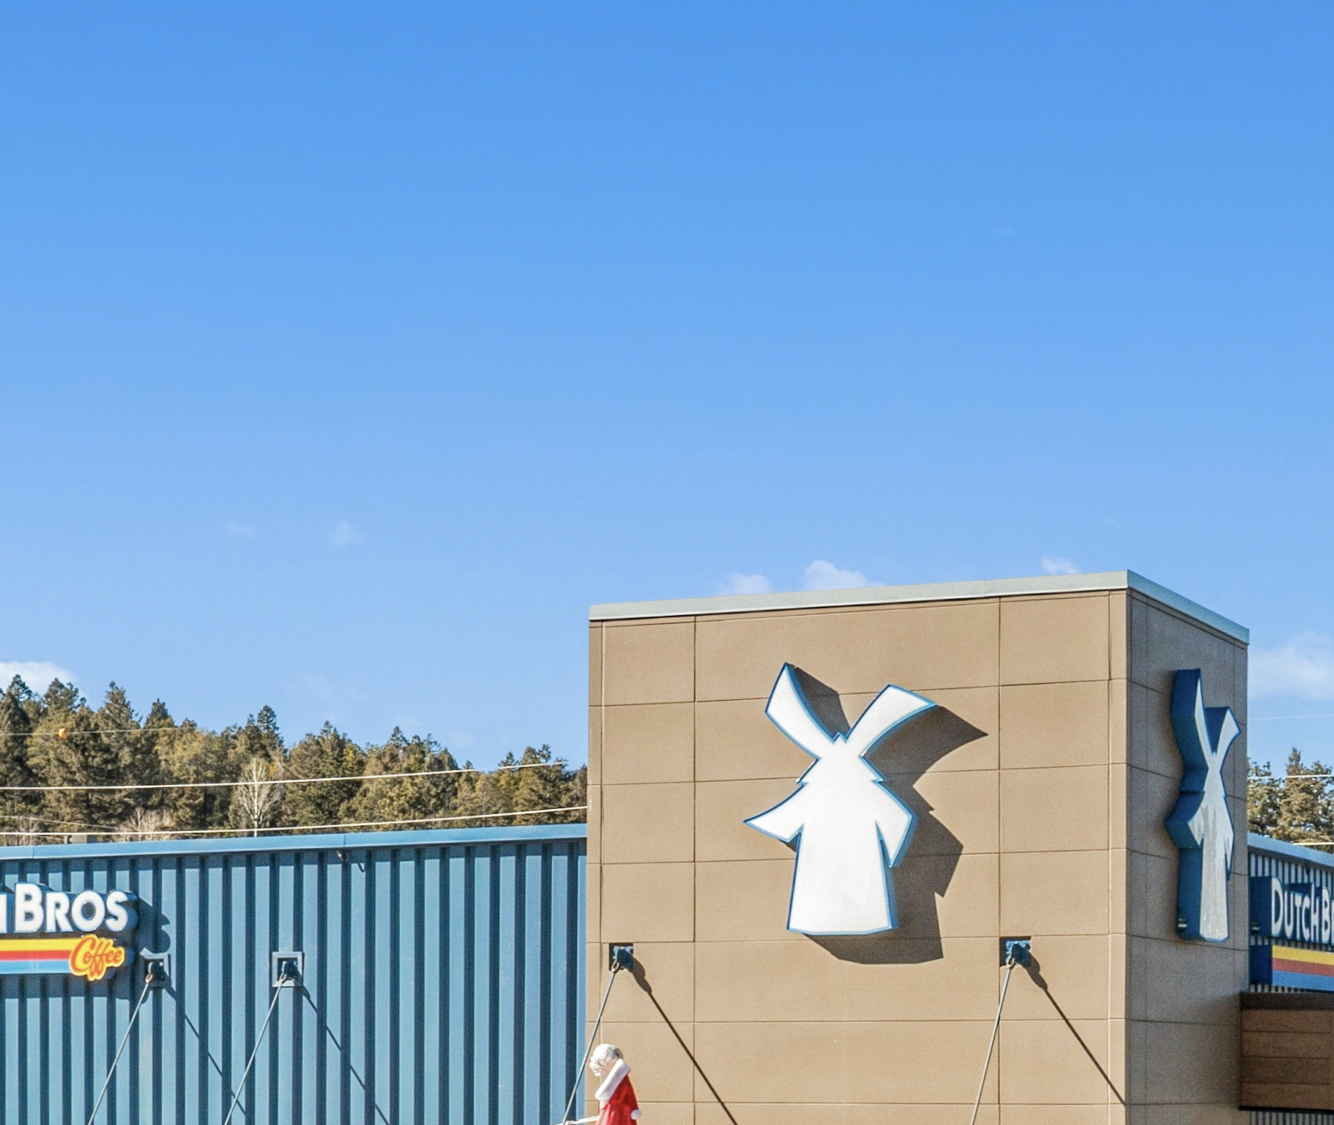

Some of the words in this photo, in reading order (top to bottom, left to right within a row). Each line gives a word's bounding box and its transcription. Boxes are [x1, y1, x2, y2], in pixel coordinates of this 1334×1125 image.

[15, 882, 129, 933] BROS
[1271, 876, 1320, 942] DUTCH
[70, 934, 124, 981] Coffee
